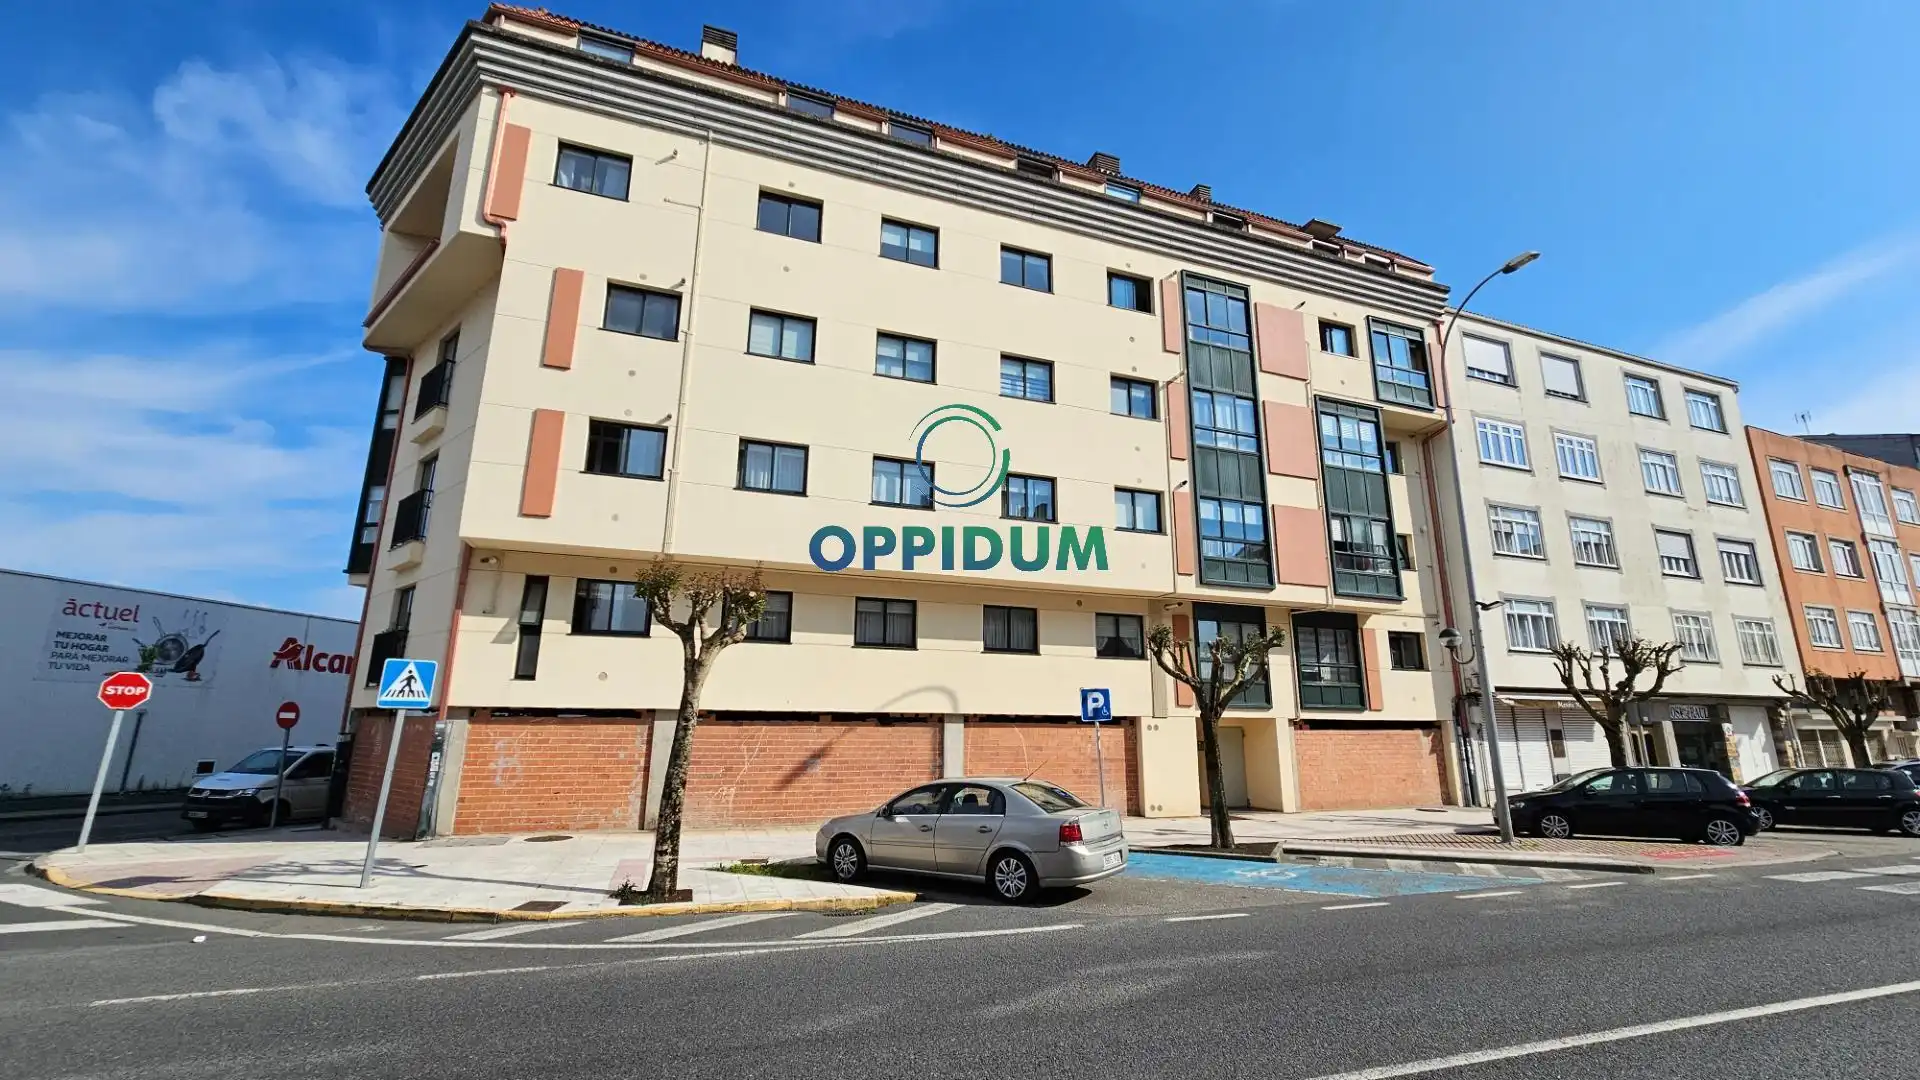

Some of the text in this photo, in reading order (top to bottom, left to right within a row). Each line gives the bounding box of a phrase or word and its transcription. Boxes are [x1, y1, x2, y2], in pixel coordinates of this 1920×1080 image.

[56, 631, 107, 642] MEJORAR
[53, 641, 109, 652] TU HOGAR
[51, 651, 129, 663] PARA MEJORAR
[48, 661, 90, 671] TU VIDA
[104, 685, 146, 696] STOP
[1087, 691, 1105, 717] P
